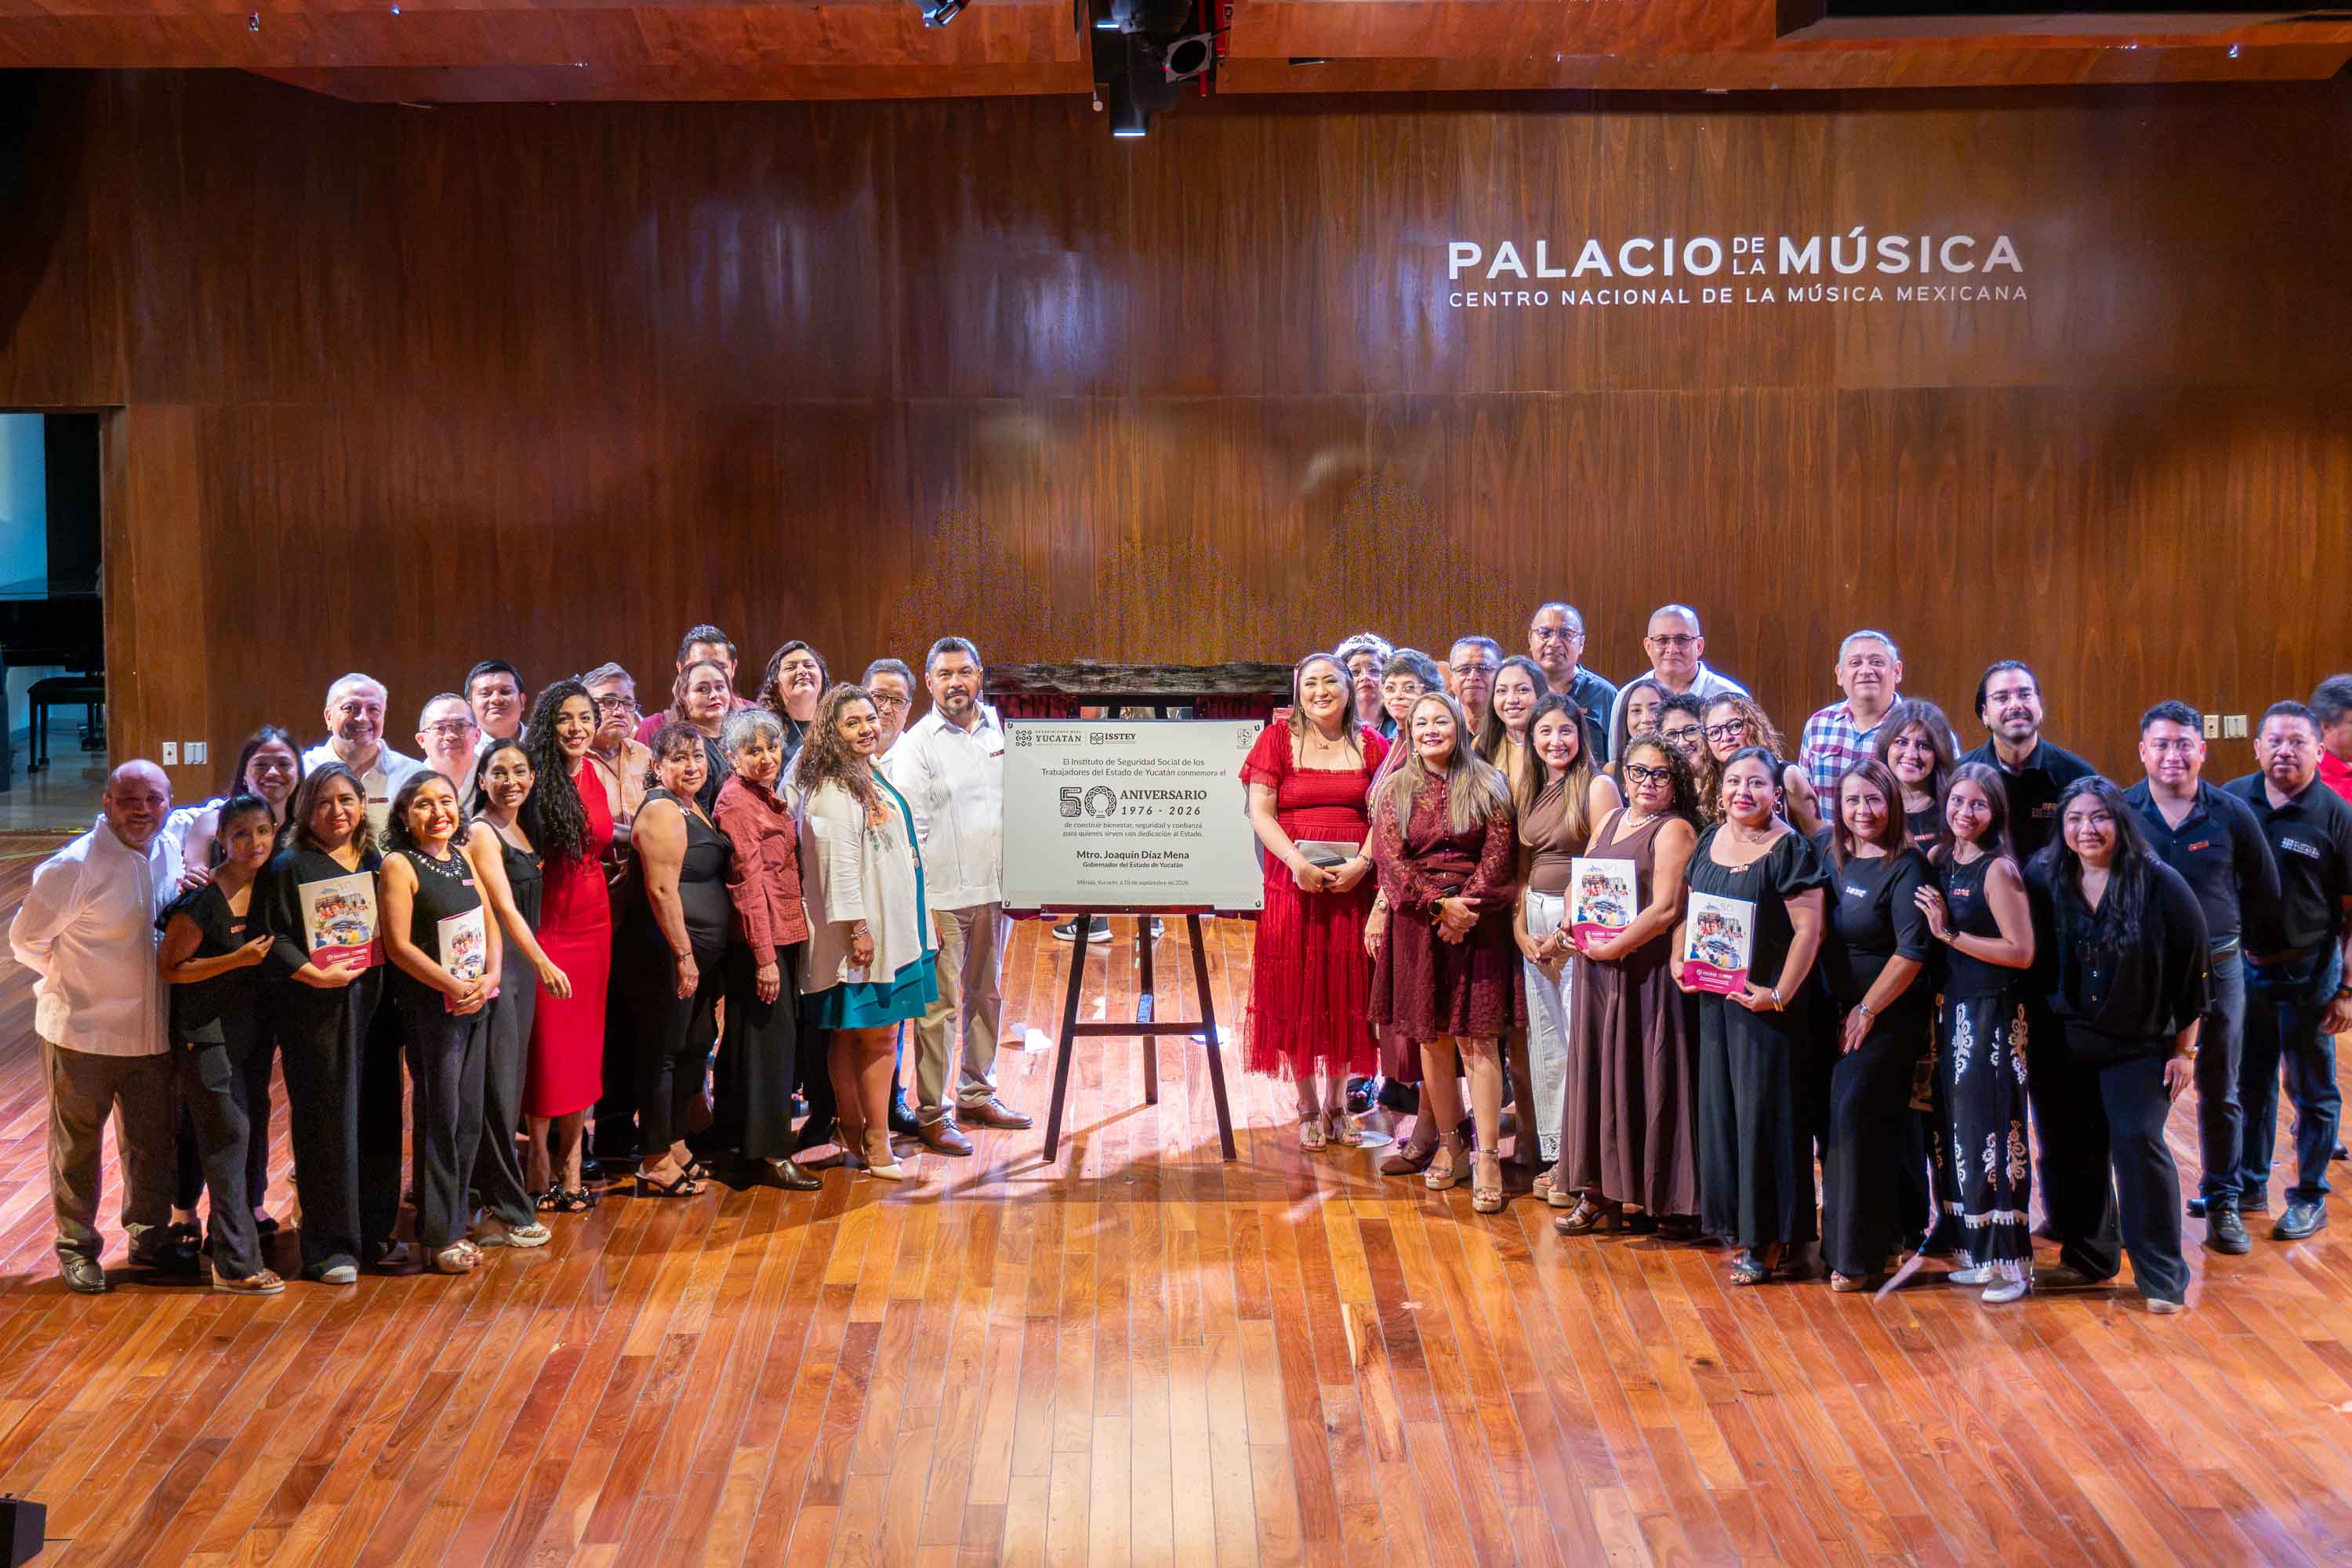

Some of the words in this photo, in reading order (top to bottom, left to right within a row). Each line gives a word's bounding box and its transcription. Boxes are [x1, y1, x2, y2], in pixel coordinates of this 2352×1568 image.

[1733, 237, 1765, 254] DE
[1778, 225, 2024, 275] MÚSICA
[1448, 238, 1721, 280] PALACIO
[1733, 258, 1766, 275] LA
[1449, 290, 1549, 308] CENTRO
[1561, 288, 1690, 306] NACIONAL
[1702, 287, 1733, 304] DE
[1745, 286, 1776, 303] LA
[1788, 283, 1884, 303] MÚSICA
[1896, 285, 2027, 302] MEXICANA
[1035, 734, 1082, 742] YUCATÁN
[1117, 758, 1156, 768] Seguridad
[1041, 768, 1091, 778] Trabajadores
[1120, 789, 1208, 800] ANIVERSARIO
[1121, 806, 1153, 815] 1976
[1168, 806, 1201, 816] 2026
[1076, 851, 1102, 860] Mtro.
[1103, 850, 1140, 861] Joaquín
[1141, 850, 1162, 860] Díaz
[1163, 851, 1190, 860] Mena
